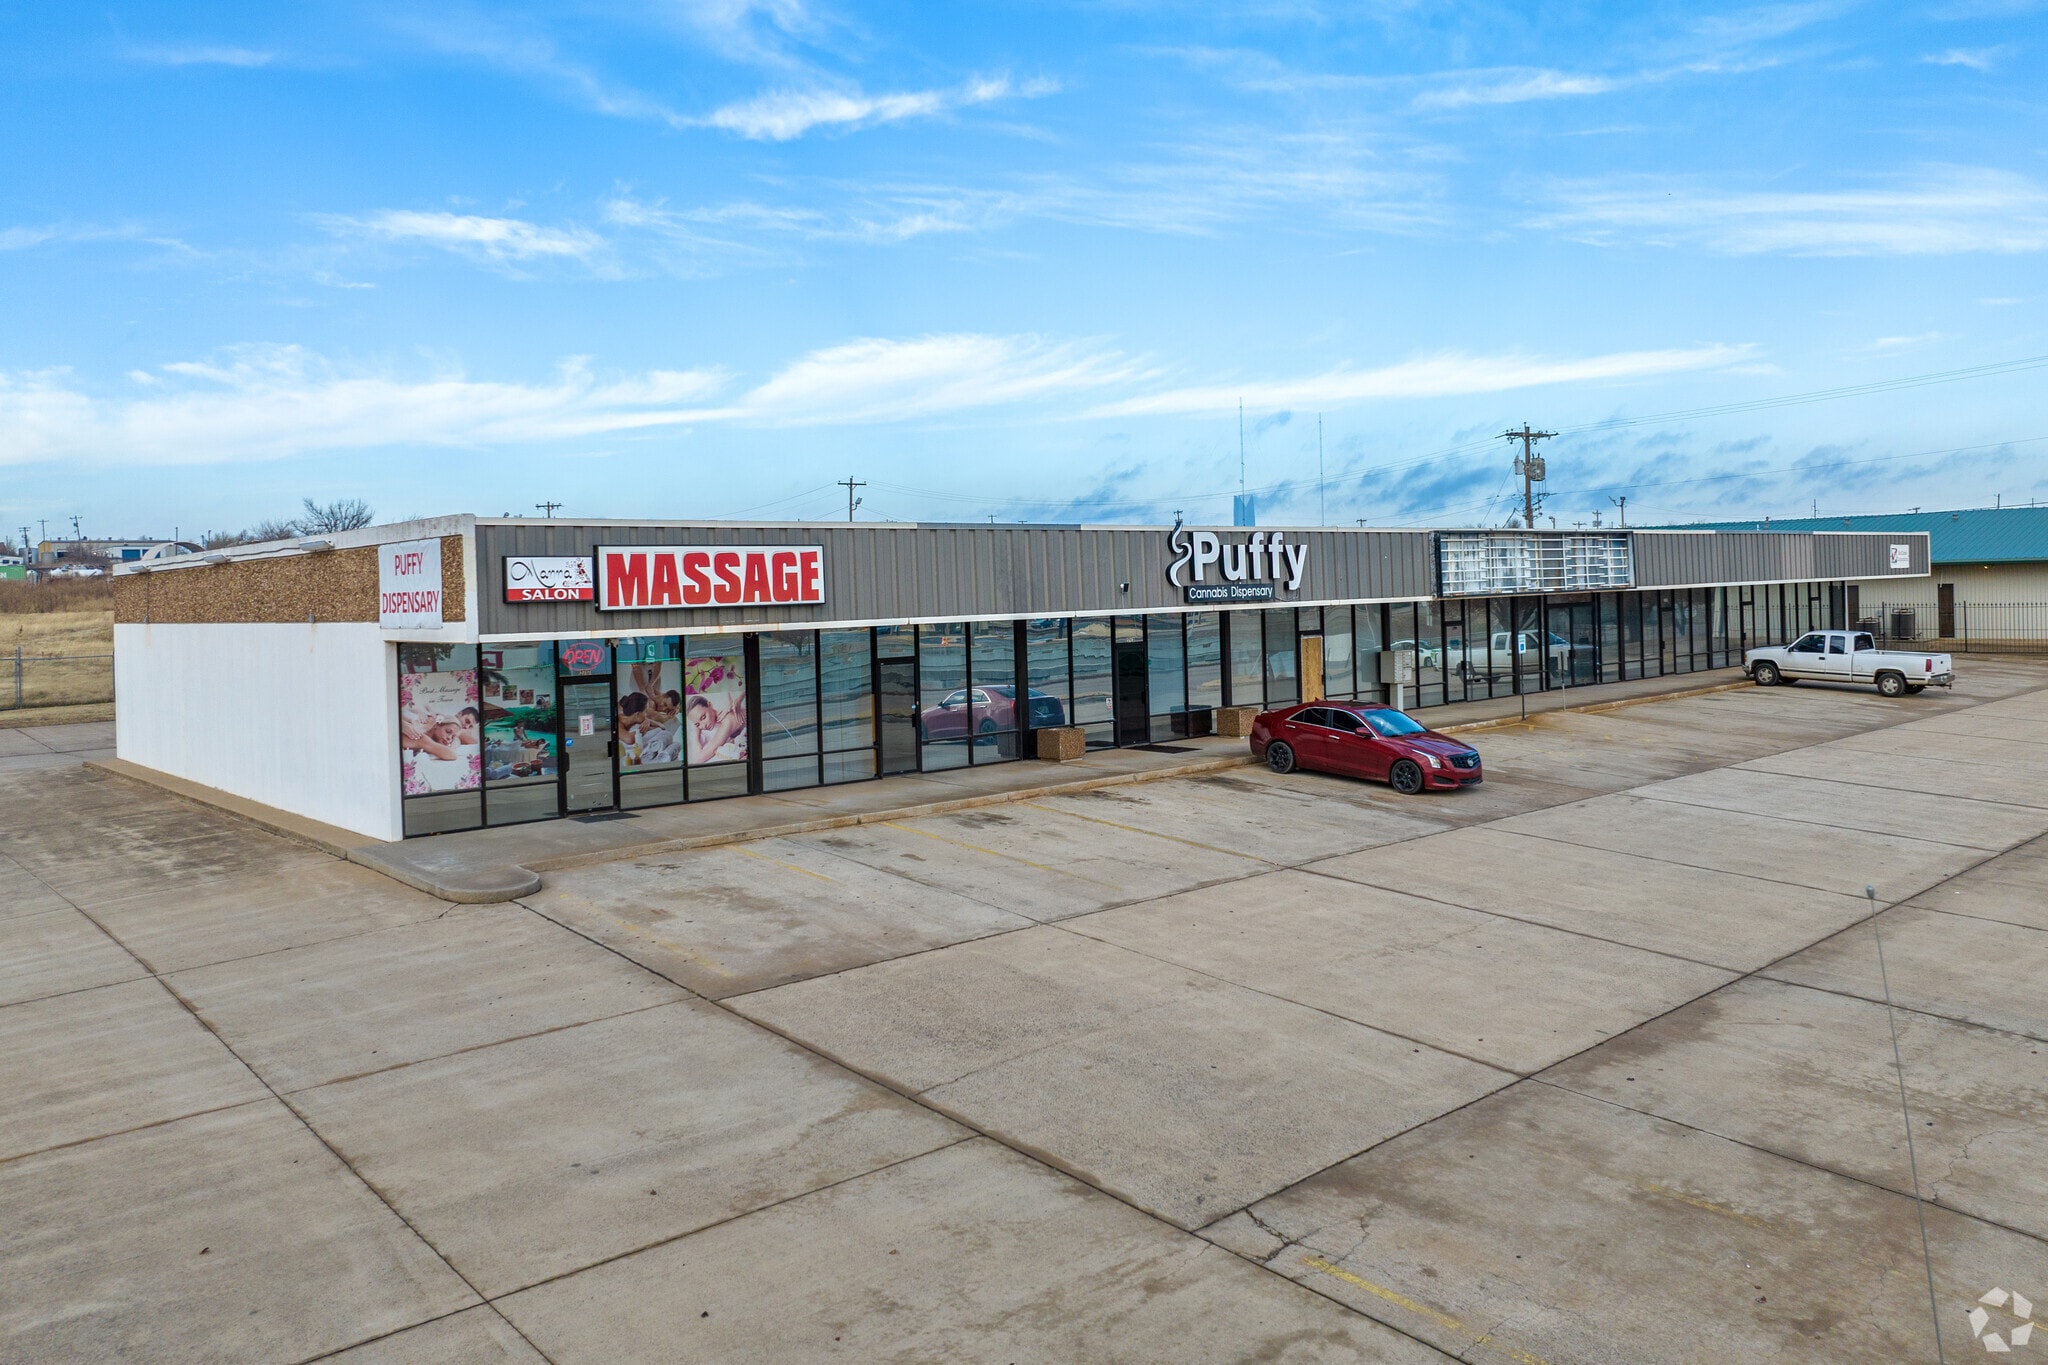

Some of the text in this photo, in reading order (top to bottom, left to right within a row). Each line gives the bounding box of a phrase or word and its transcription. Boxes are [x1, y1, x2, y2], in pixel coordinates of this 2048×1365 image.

[394, 552, 424, 576] PUFFY
[1192, 531, 1307, 591] Puffy
[606, 551, 820, 607] MASSAGE
[382, 590, 440, 614] DISPENSARY
[522, 588, 580, 601] SALON
[1189, 585, 1273, 599] Cannabis Dispensary
[563, 649, 601, 665] OPEN
